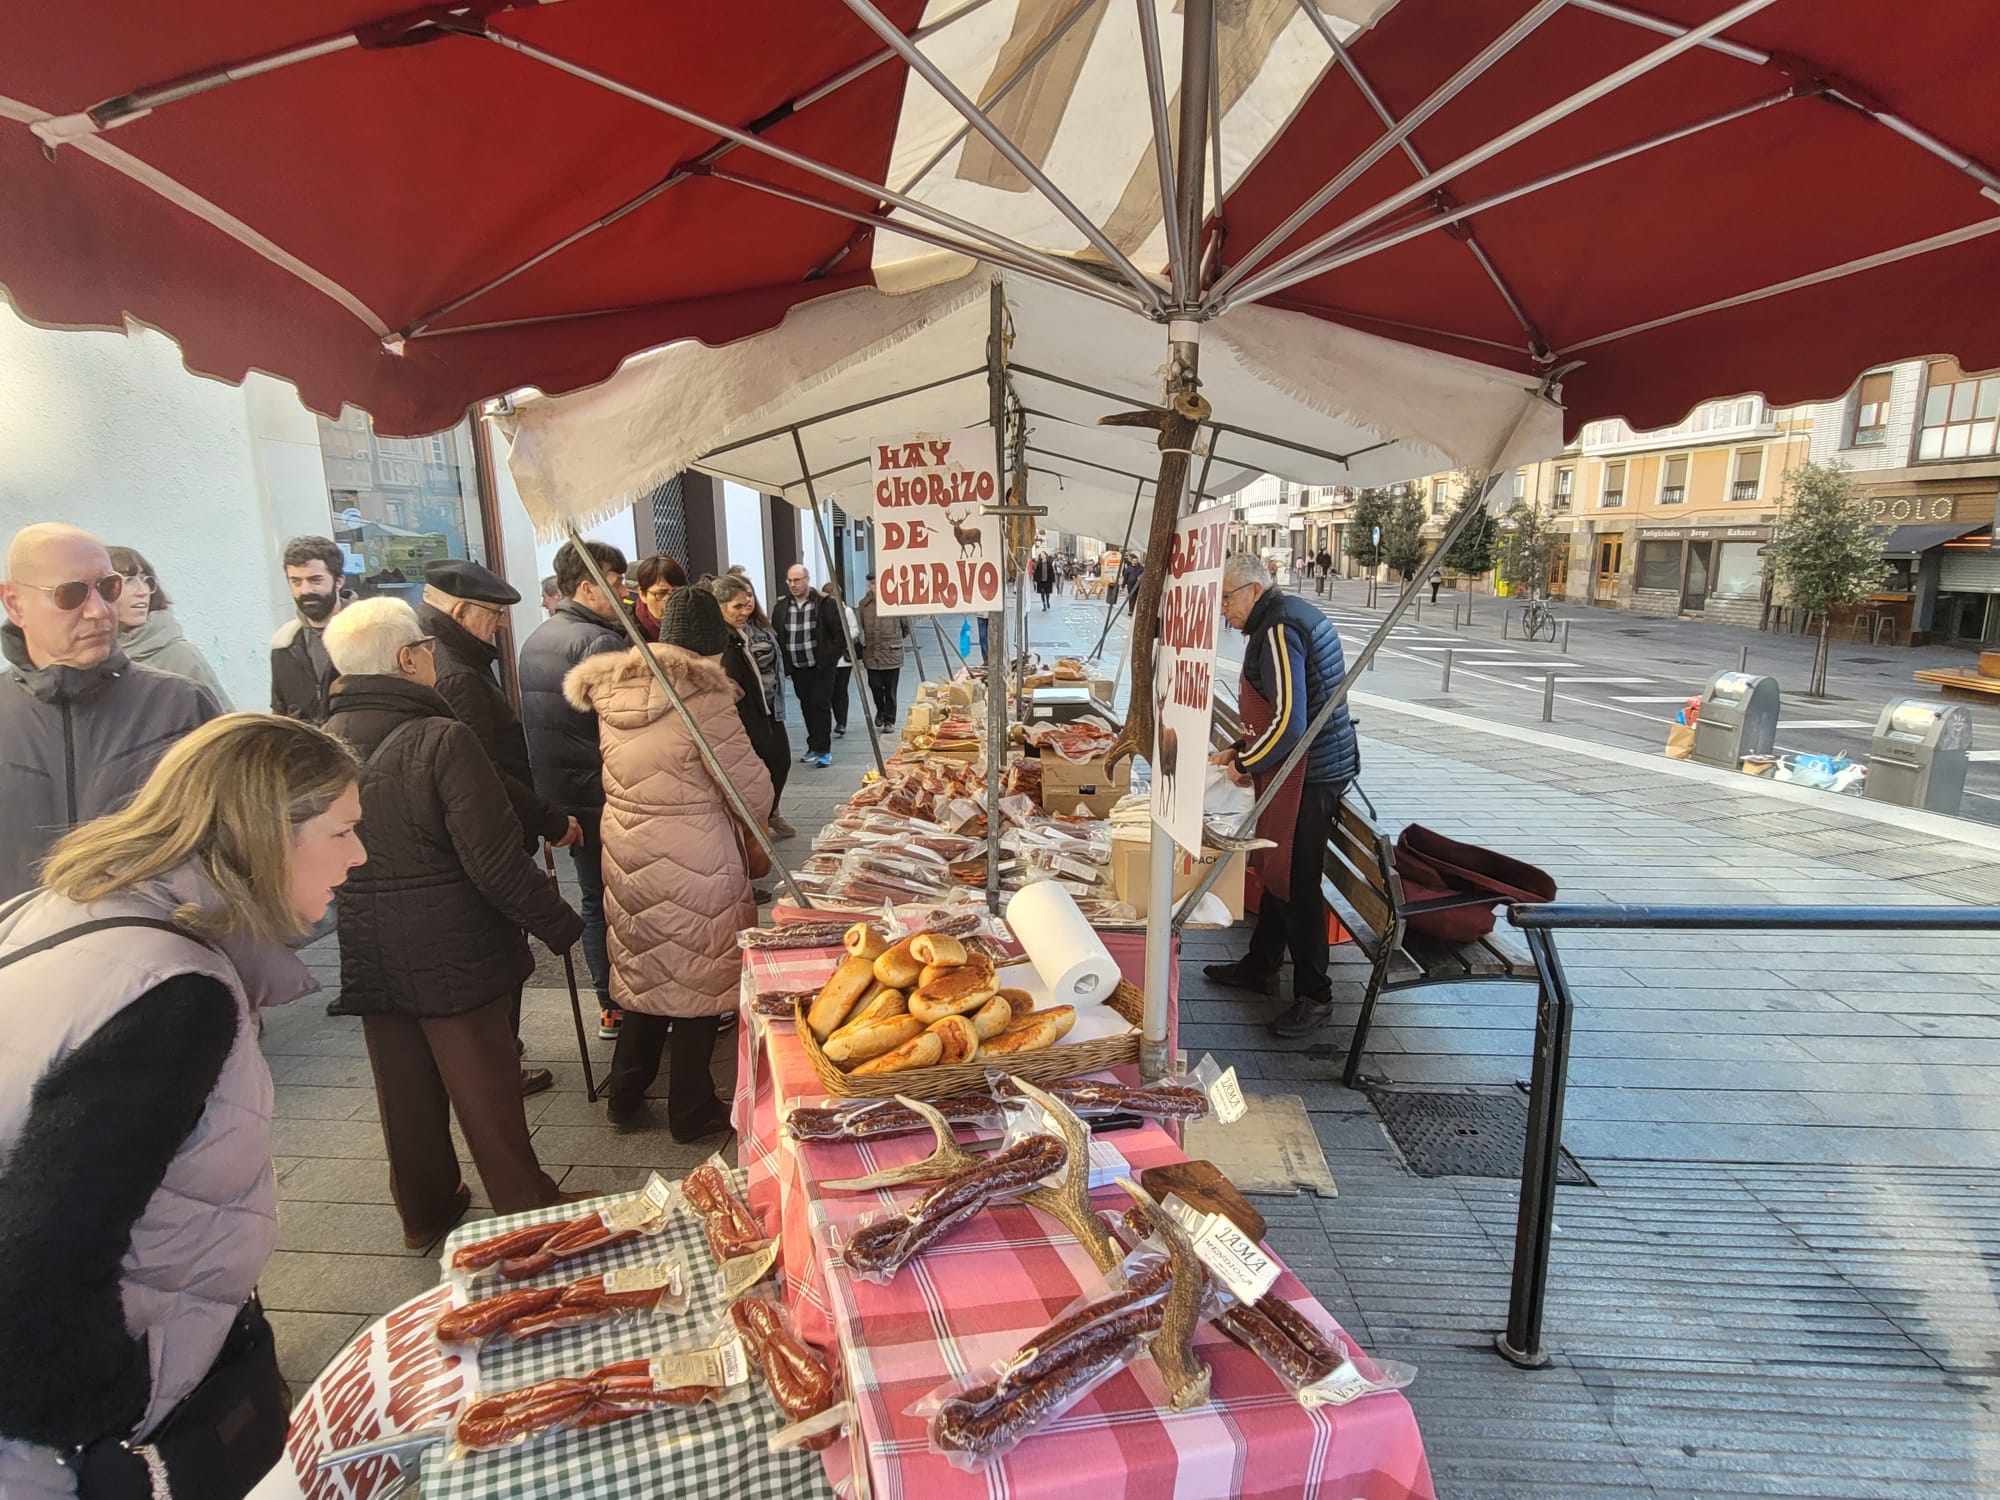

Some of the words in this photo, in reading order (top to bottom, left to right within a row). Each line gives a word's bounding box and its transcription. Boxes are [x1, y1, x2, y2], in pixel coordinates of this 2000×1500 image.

[877, 440, 951, 471] HAY
[882, 519, 929, 551] DE
[1168, 522, 1226, 579] REIN
